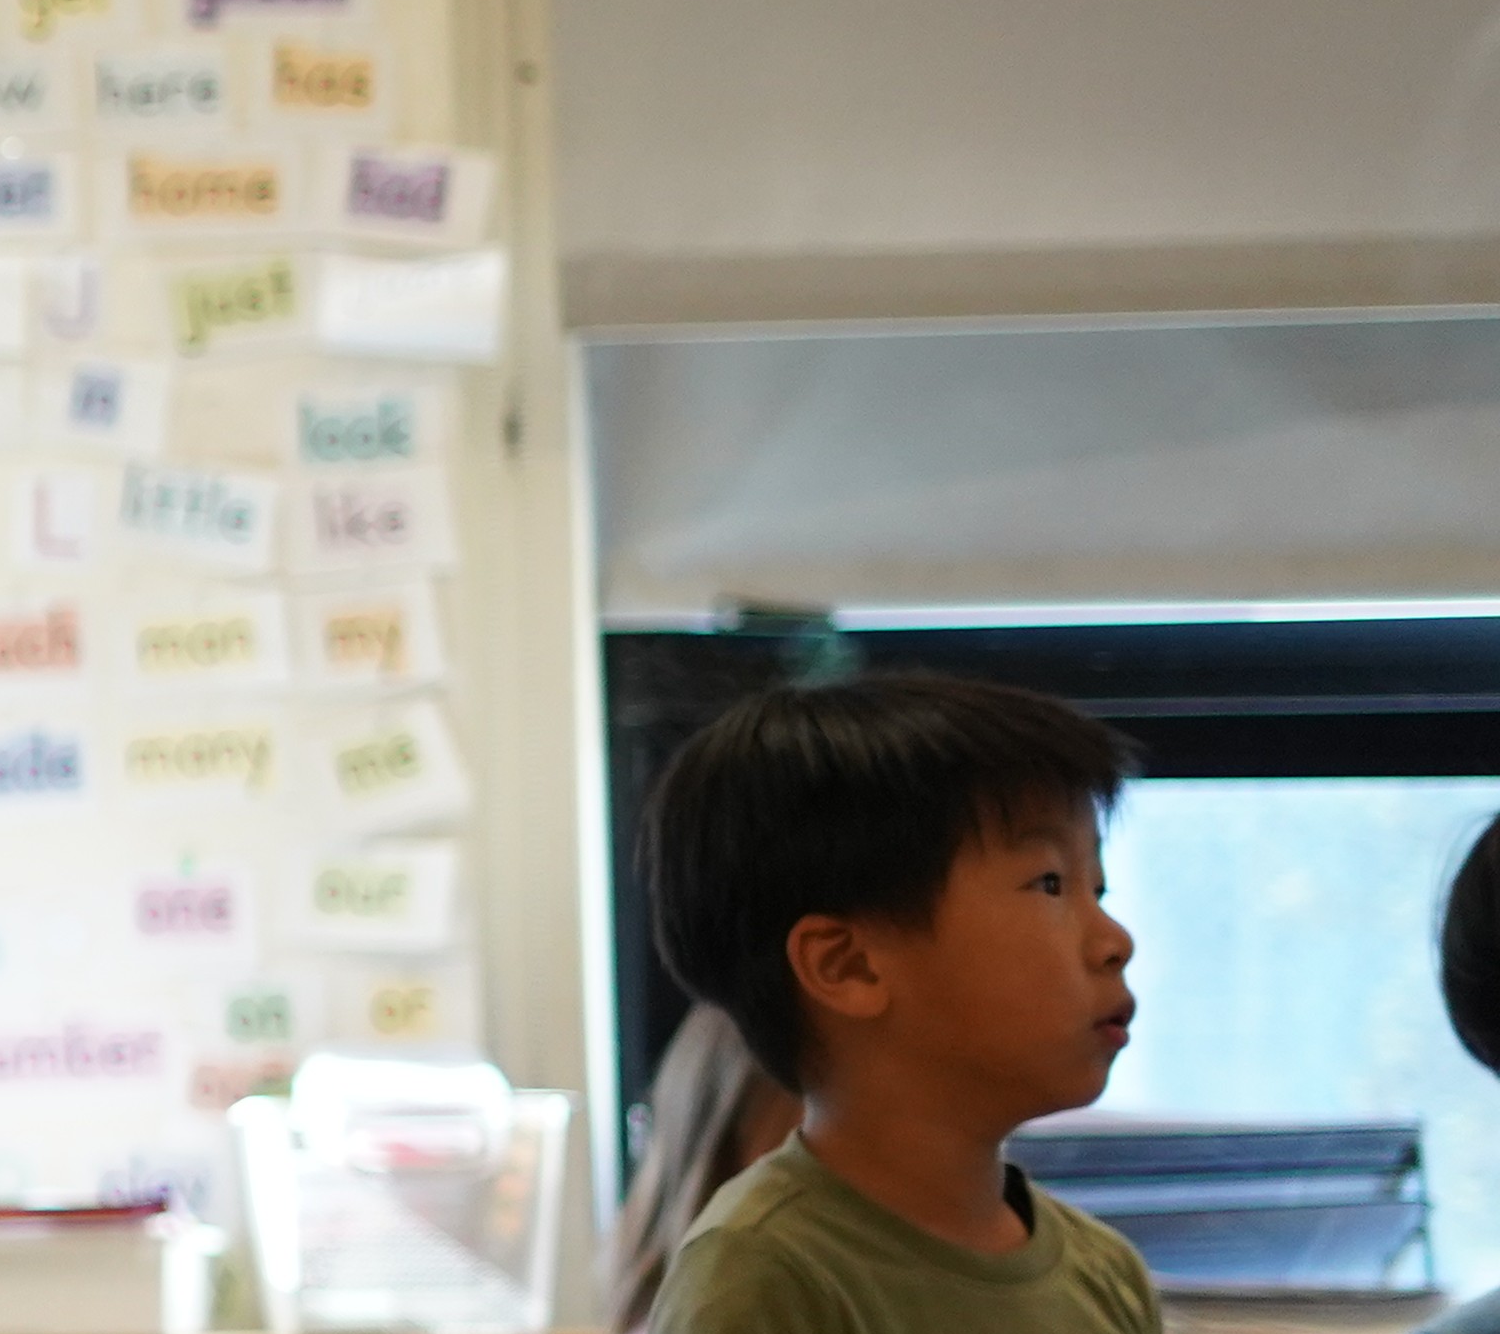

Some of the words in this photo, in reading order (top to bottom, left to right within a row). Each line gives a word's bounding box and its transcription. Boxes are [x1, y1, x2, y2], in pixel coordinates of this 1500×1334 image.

[273, 43, 375, 109] has
[128, 153, 279, 221] home
[347, 154, 450, 223] had
[178, 262, 298, 353] just
[300, 395, 414, 461] look
[33, 484, 84, 558] L
[120, 465, 260, 545] little
[314, 487, 411, 547] like
[323, 607, 407, 676] my
[125, 729, 276, 797] many
[334, 731, 424, 797] me
[133, 879, 235, 938] one
[224, 987, 293, 1041] on
